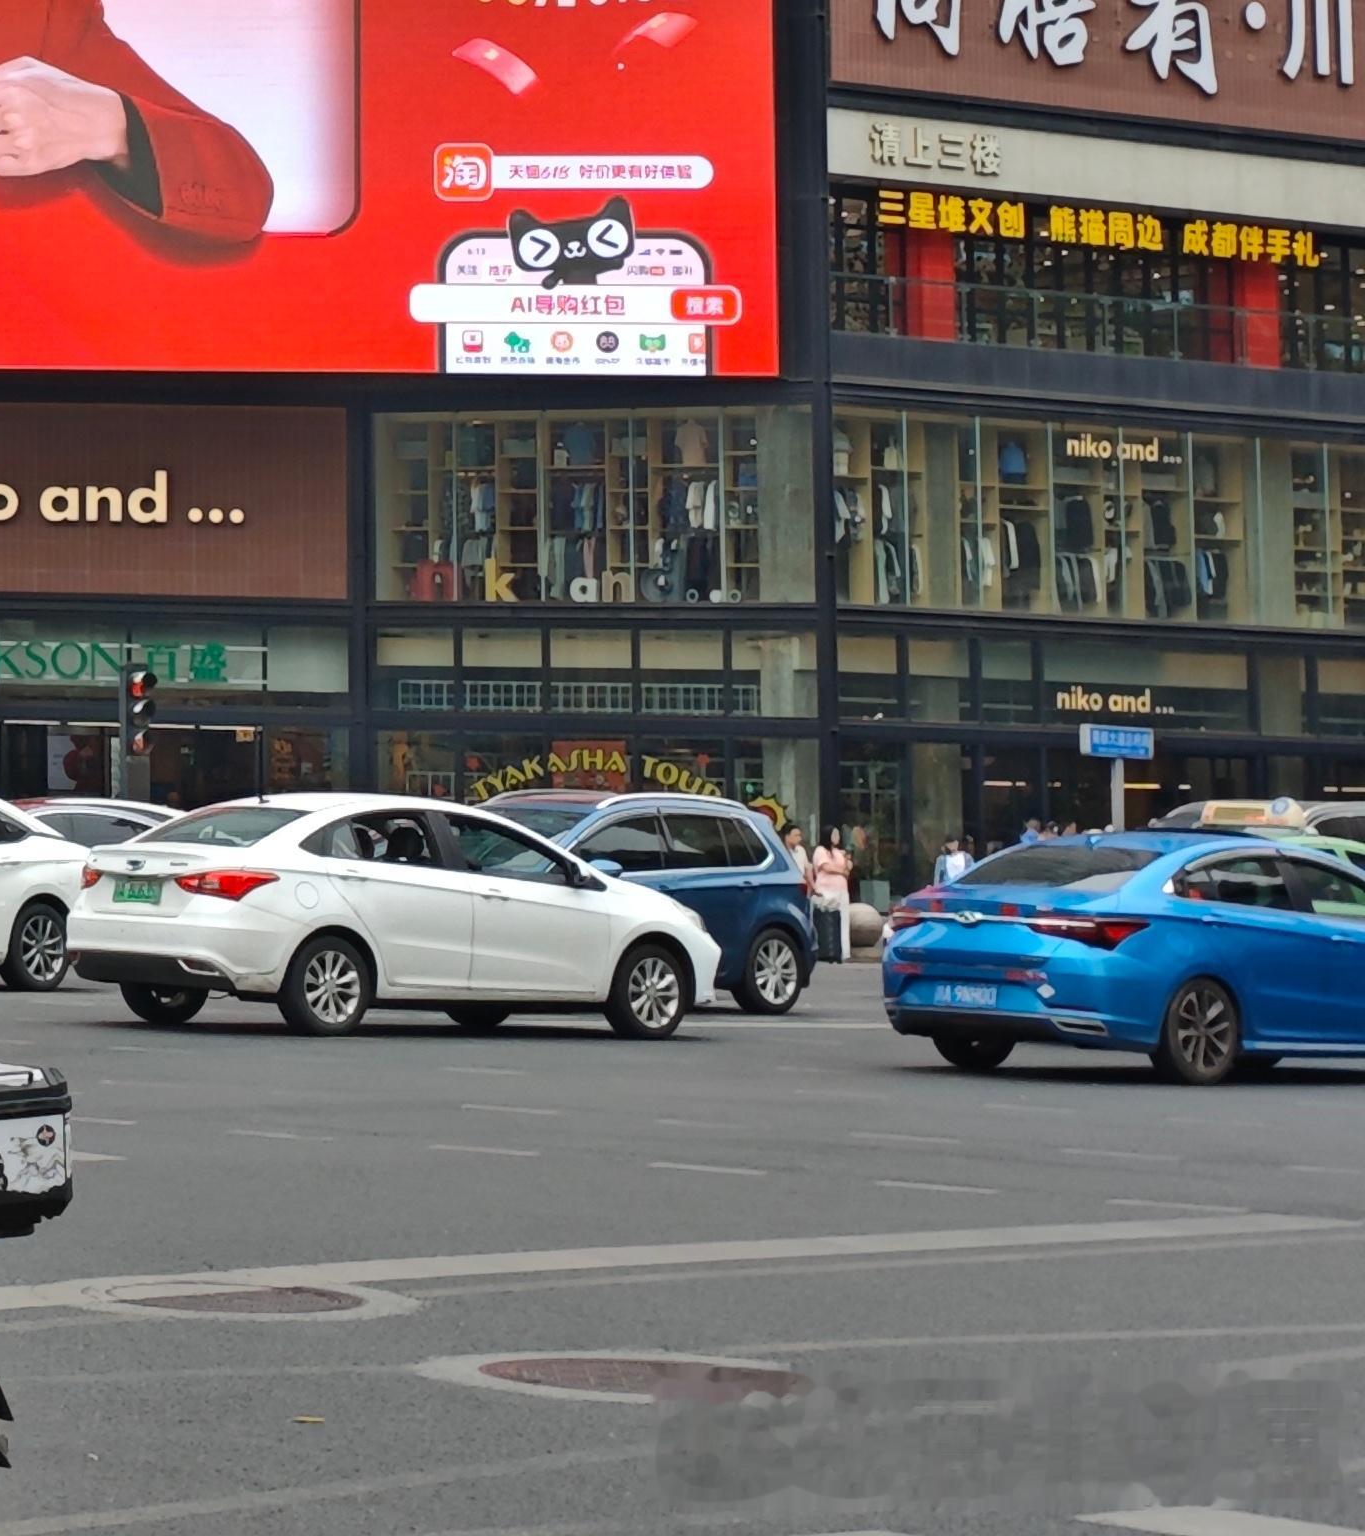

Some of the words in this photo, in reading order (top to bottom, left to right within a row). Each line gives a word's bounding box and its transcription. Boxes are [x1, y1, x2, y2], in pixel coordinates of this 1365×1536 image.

[870, 121, 1002, 176] 请上三楼
[878, 189, 1026, 240] 三星堆文创
[1049, 204, 1164, 253] 熊猫周边
[1181, 220, 1320, 268] 成都伴手礼
[510, 294, 626, 316] AI导购红包
[1066, 432, 1113, 462] niko
[1116, 435, 1160, 463] and
[39, 469, 169, 525] and
[139, 640, 227, 682] 百盛
[1056, 684, 1104, 712] niko
[1108, 687, 1151, 714] and
[470, 748, 628, 802] TYAKASHA
